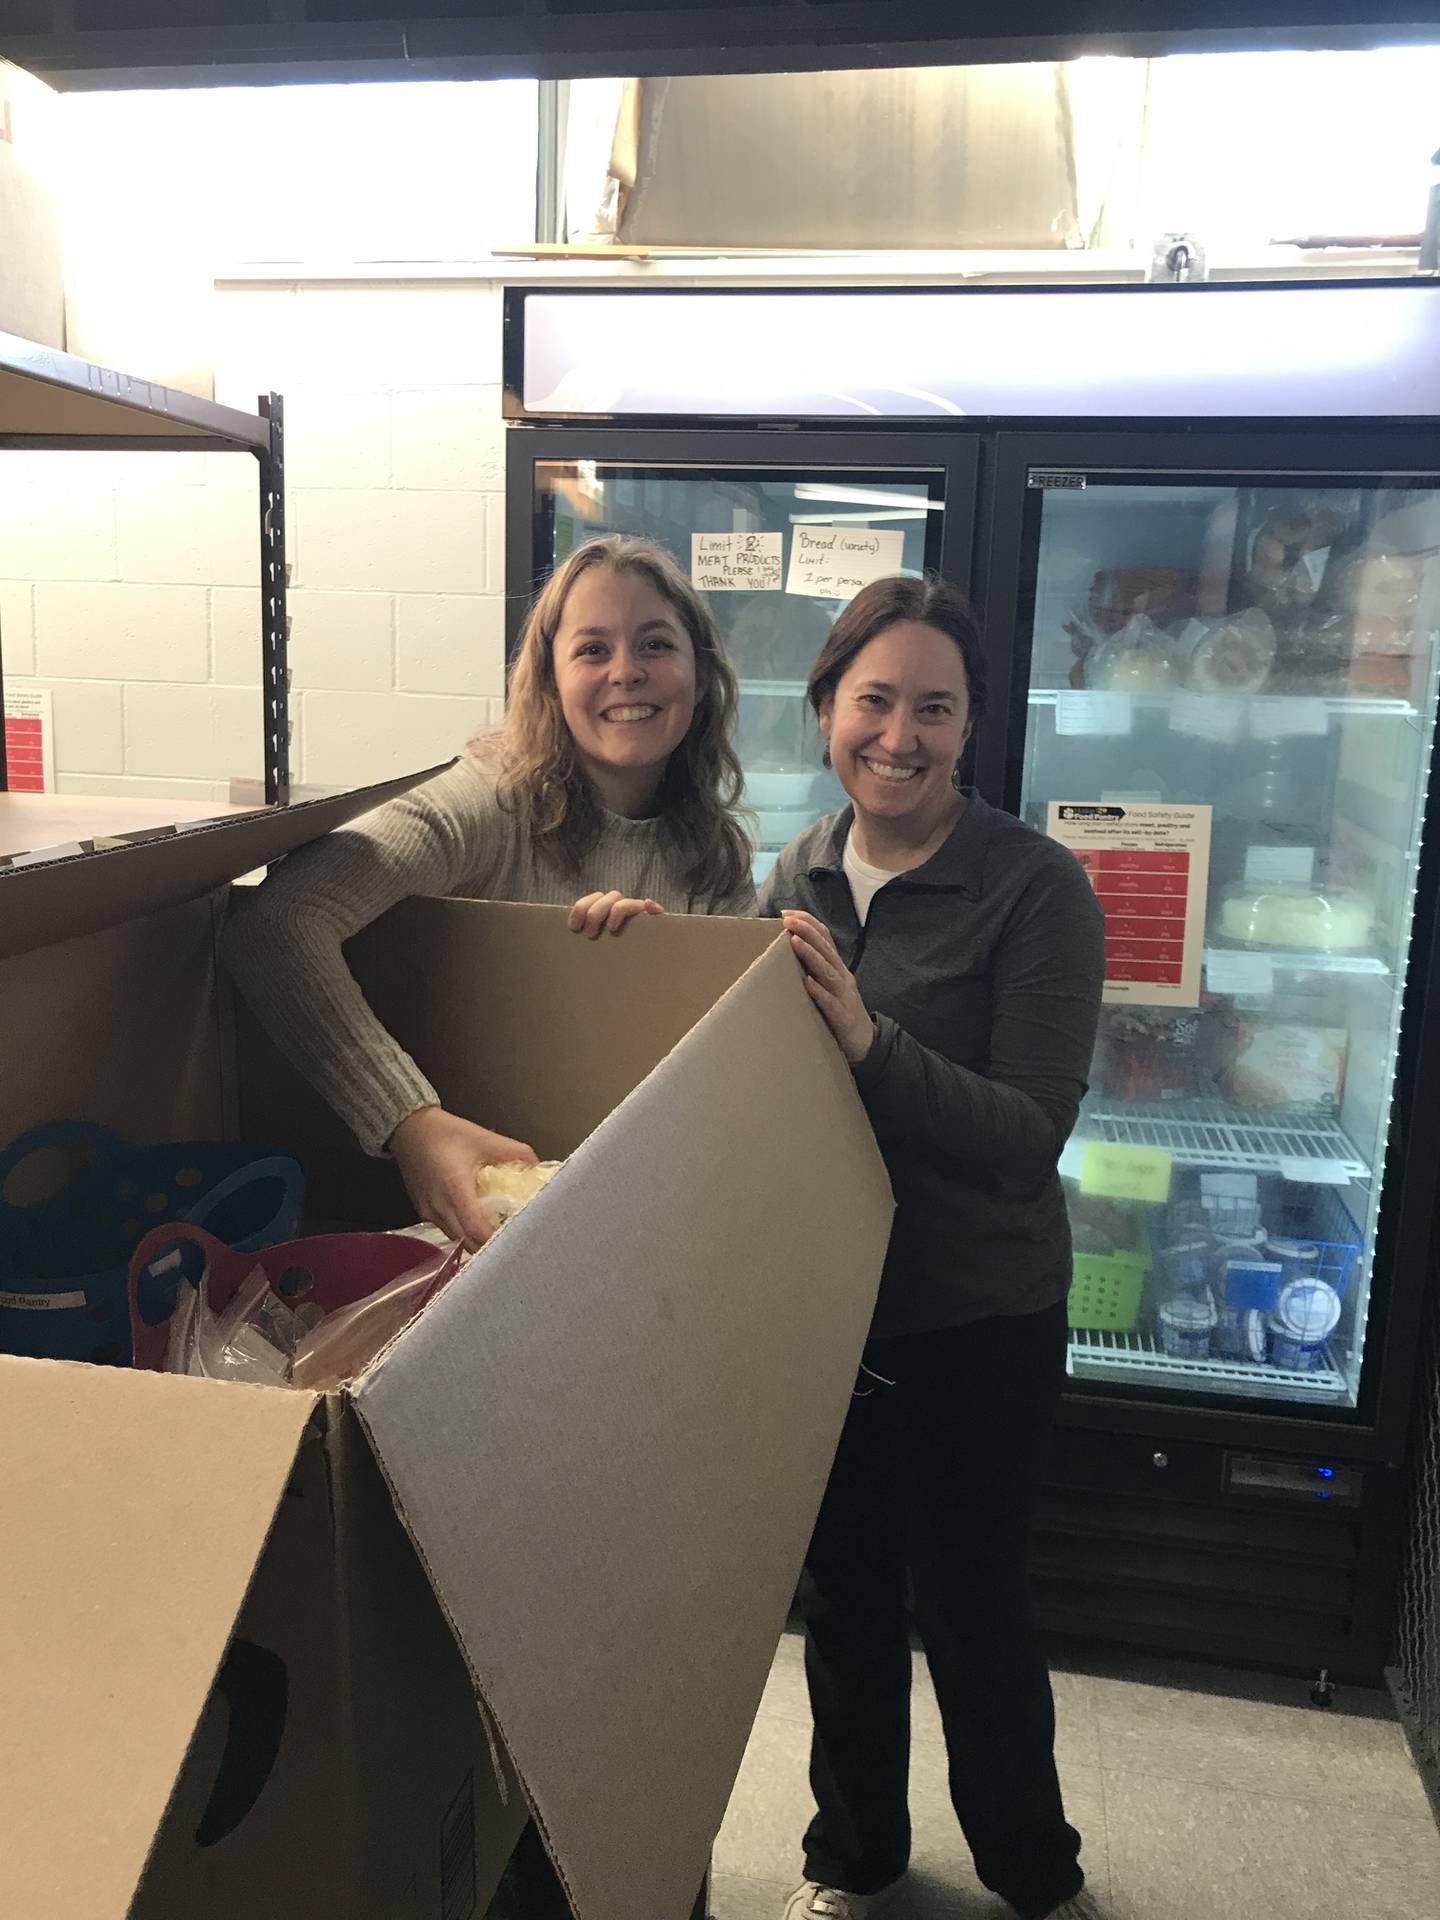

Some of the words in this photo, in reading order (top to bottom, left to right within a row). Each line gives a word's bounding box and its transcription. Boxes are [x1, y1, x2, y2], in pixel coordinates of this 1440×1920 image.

[700, 536, 732, 551] Limit
[799, 532, 837, 549] Bread
[698, 555, 728, 566] MEAT
[736, 552, 780, 565] PRODUCTS
[722, 565, 753, 575] PLEASE
[699, 575, 736, 588] THANK
[815, 575, 833, 585] per
[1148, 811, 1171, 819] Safety
[0, 1296, 17, 1304] ood
